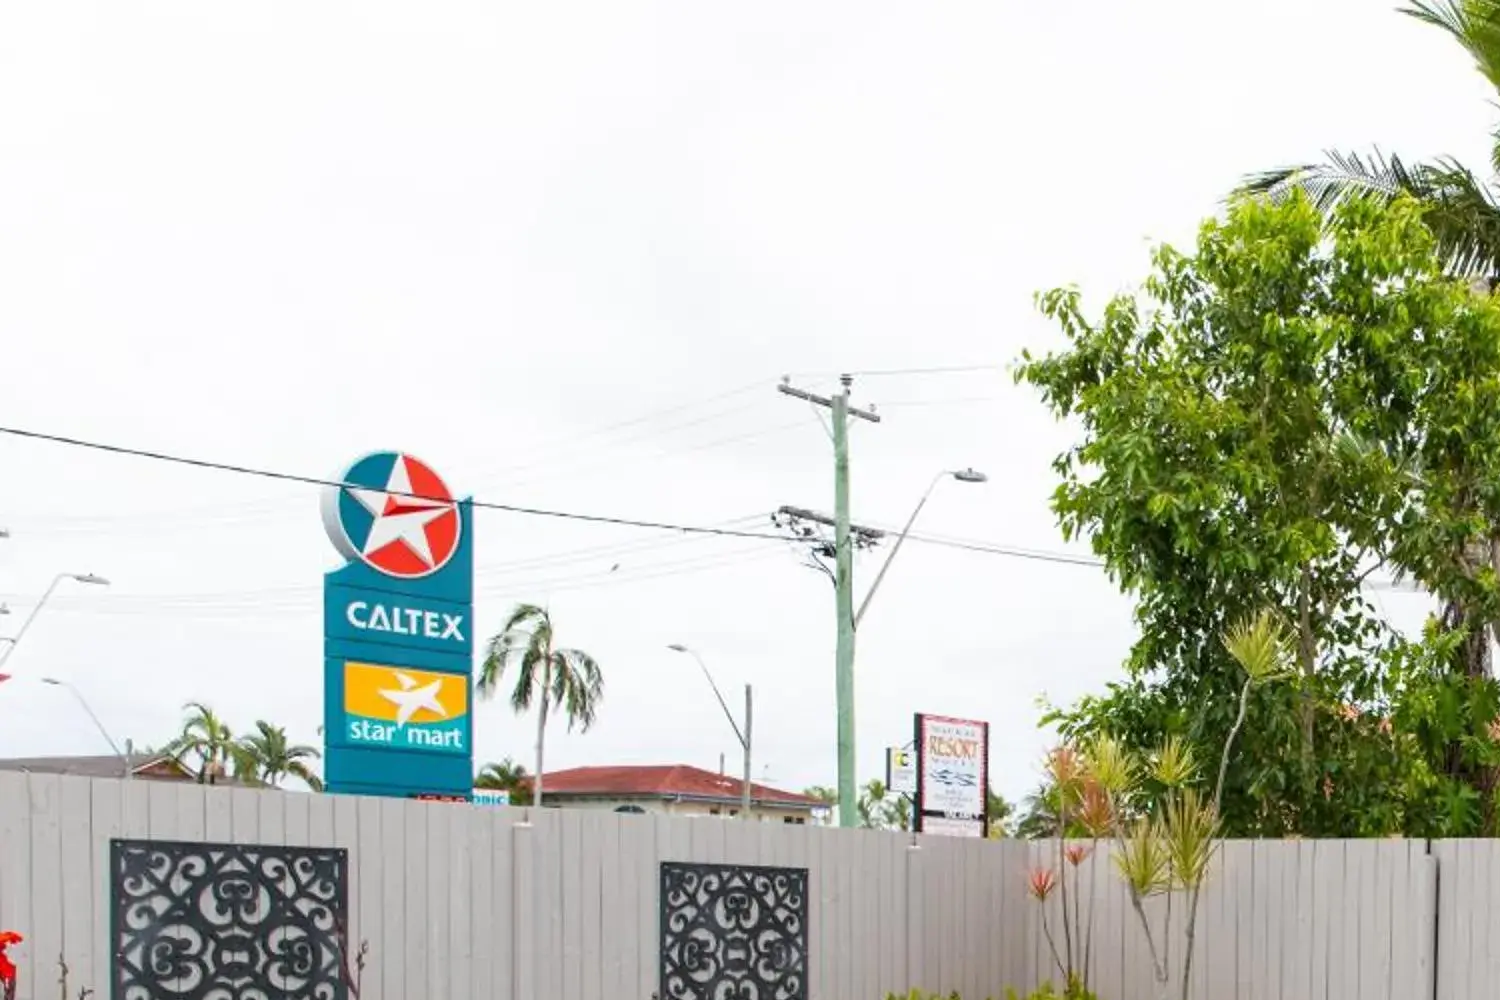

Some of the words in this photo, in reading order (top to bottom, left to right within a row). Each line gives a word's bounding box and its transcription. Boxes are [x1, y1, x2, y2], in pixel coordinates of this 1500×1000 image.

[346, 601, 465, 641] CALTEX
[350, 719, 396, 742] star
[407, 725, 463, 748] mart
[929, 735, 978, 760] RESORT
